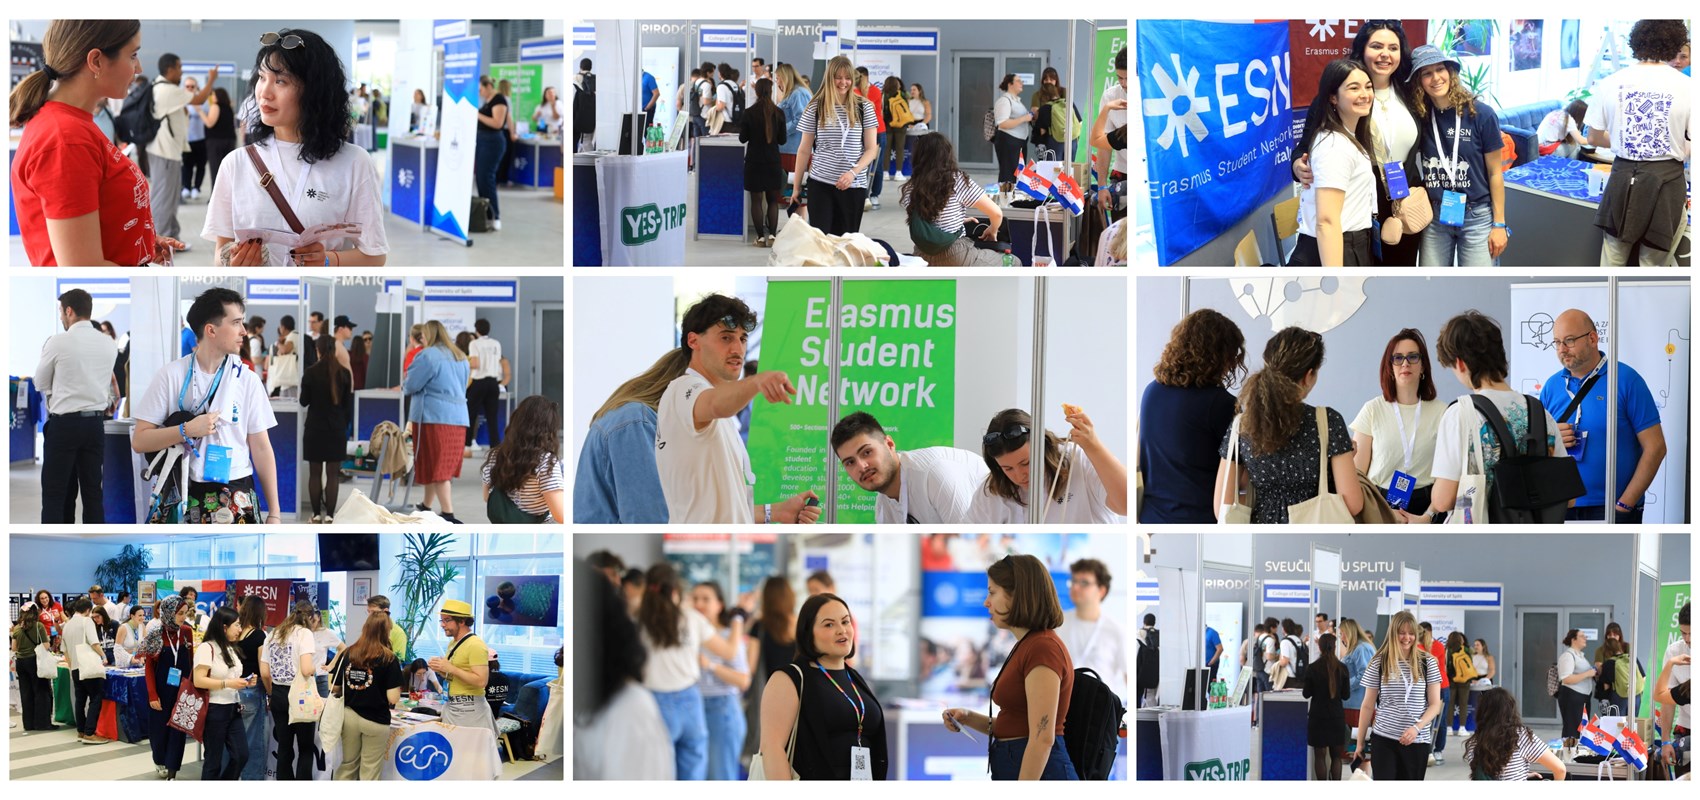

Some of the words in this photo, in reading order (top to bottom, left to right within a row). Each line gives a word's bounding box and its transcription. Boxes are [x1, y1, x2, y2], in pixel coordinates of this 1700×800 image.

[1305, 47, 1339, 56] Erasmus
[1215, 52, 1291, 139] ESN
[1149, 168, 1212, 199] Erasmus
[1218, 147, 1257, 177] Student
[1260, 126, 1293, 156] Netork
[625, 203, 687, 238] YES-TRIP
[1353, 561, 1394, 573] SPLITU
[255, 586, 278, 600] ESN
